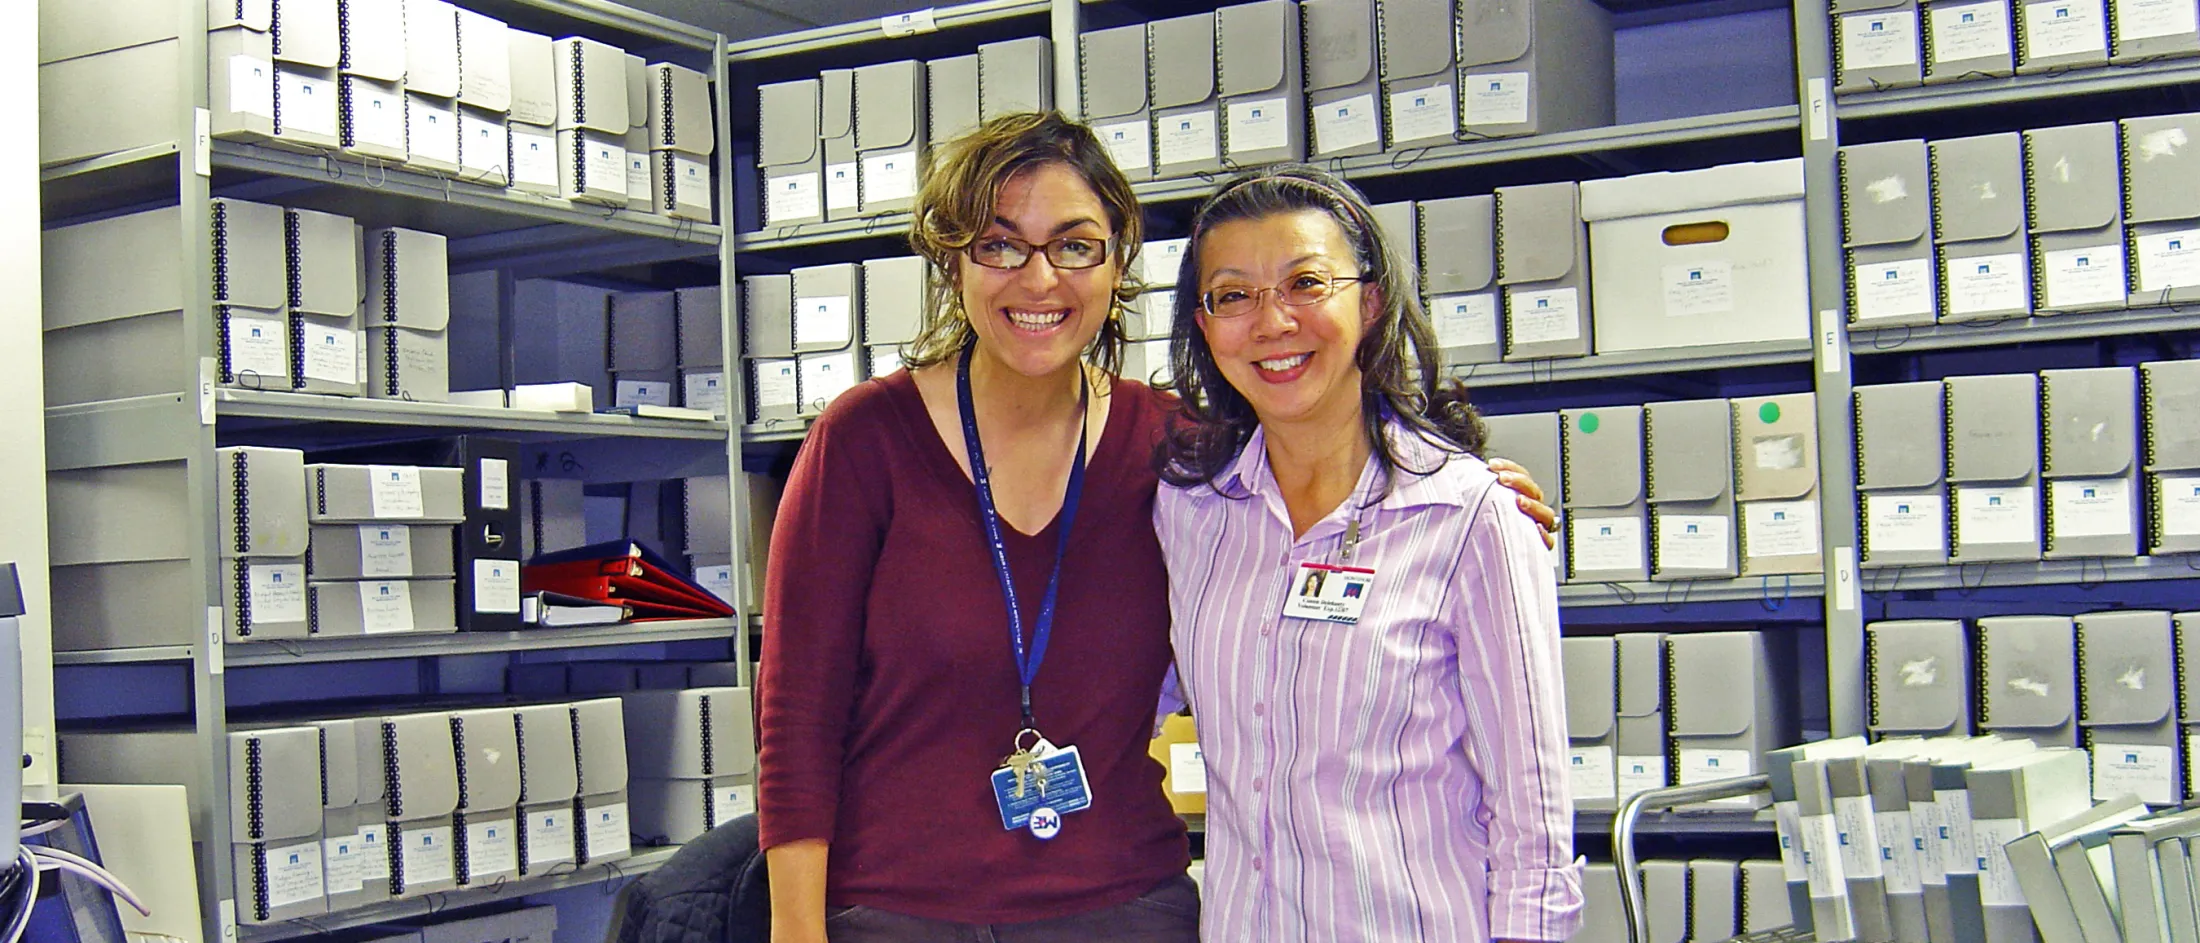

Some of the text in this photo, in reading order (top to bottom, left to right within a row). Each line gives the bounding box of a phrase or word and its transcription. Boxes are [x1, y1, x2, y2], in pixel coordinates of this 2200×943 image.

[1813, 99, 1821, 114] F
[199, 134, 206, 146] F
[1826, 331, 1834, 345] E
[203, 382, 210, 395] E
[1840, 569, 1849, 582] D
[212, 632, 220, 645] D
[224, 924, 233, 938] C
